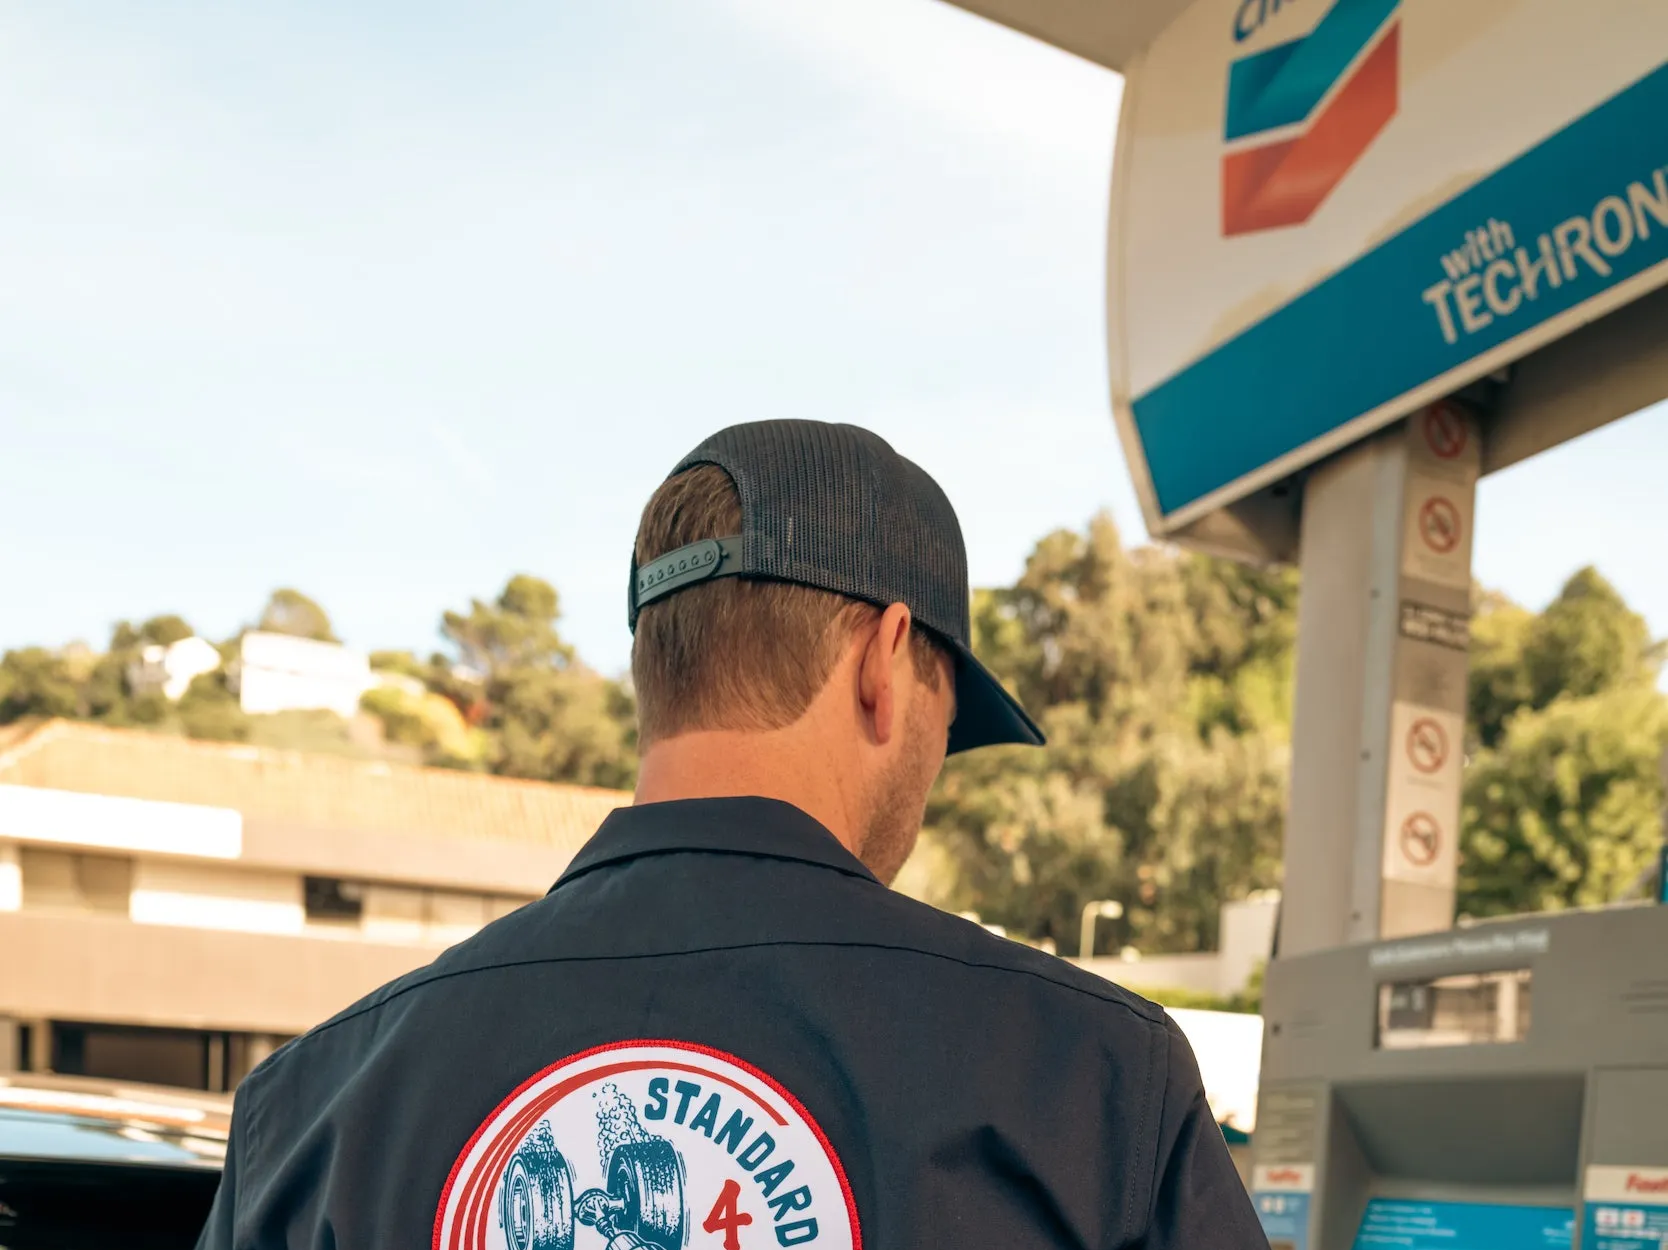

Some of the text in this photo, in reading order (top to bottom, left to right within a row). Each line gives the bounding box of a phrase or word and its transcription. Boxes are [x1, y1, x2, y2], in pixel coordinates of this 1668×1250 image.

[1422, 168, 1668, 344] TECHRON
[1440, 217, 1515, 280] with
[645, 1077, 820, 1248] STANDARD
